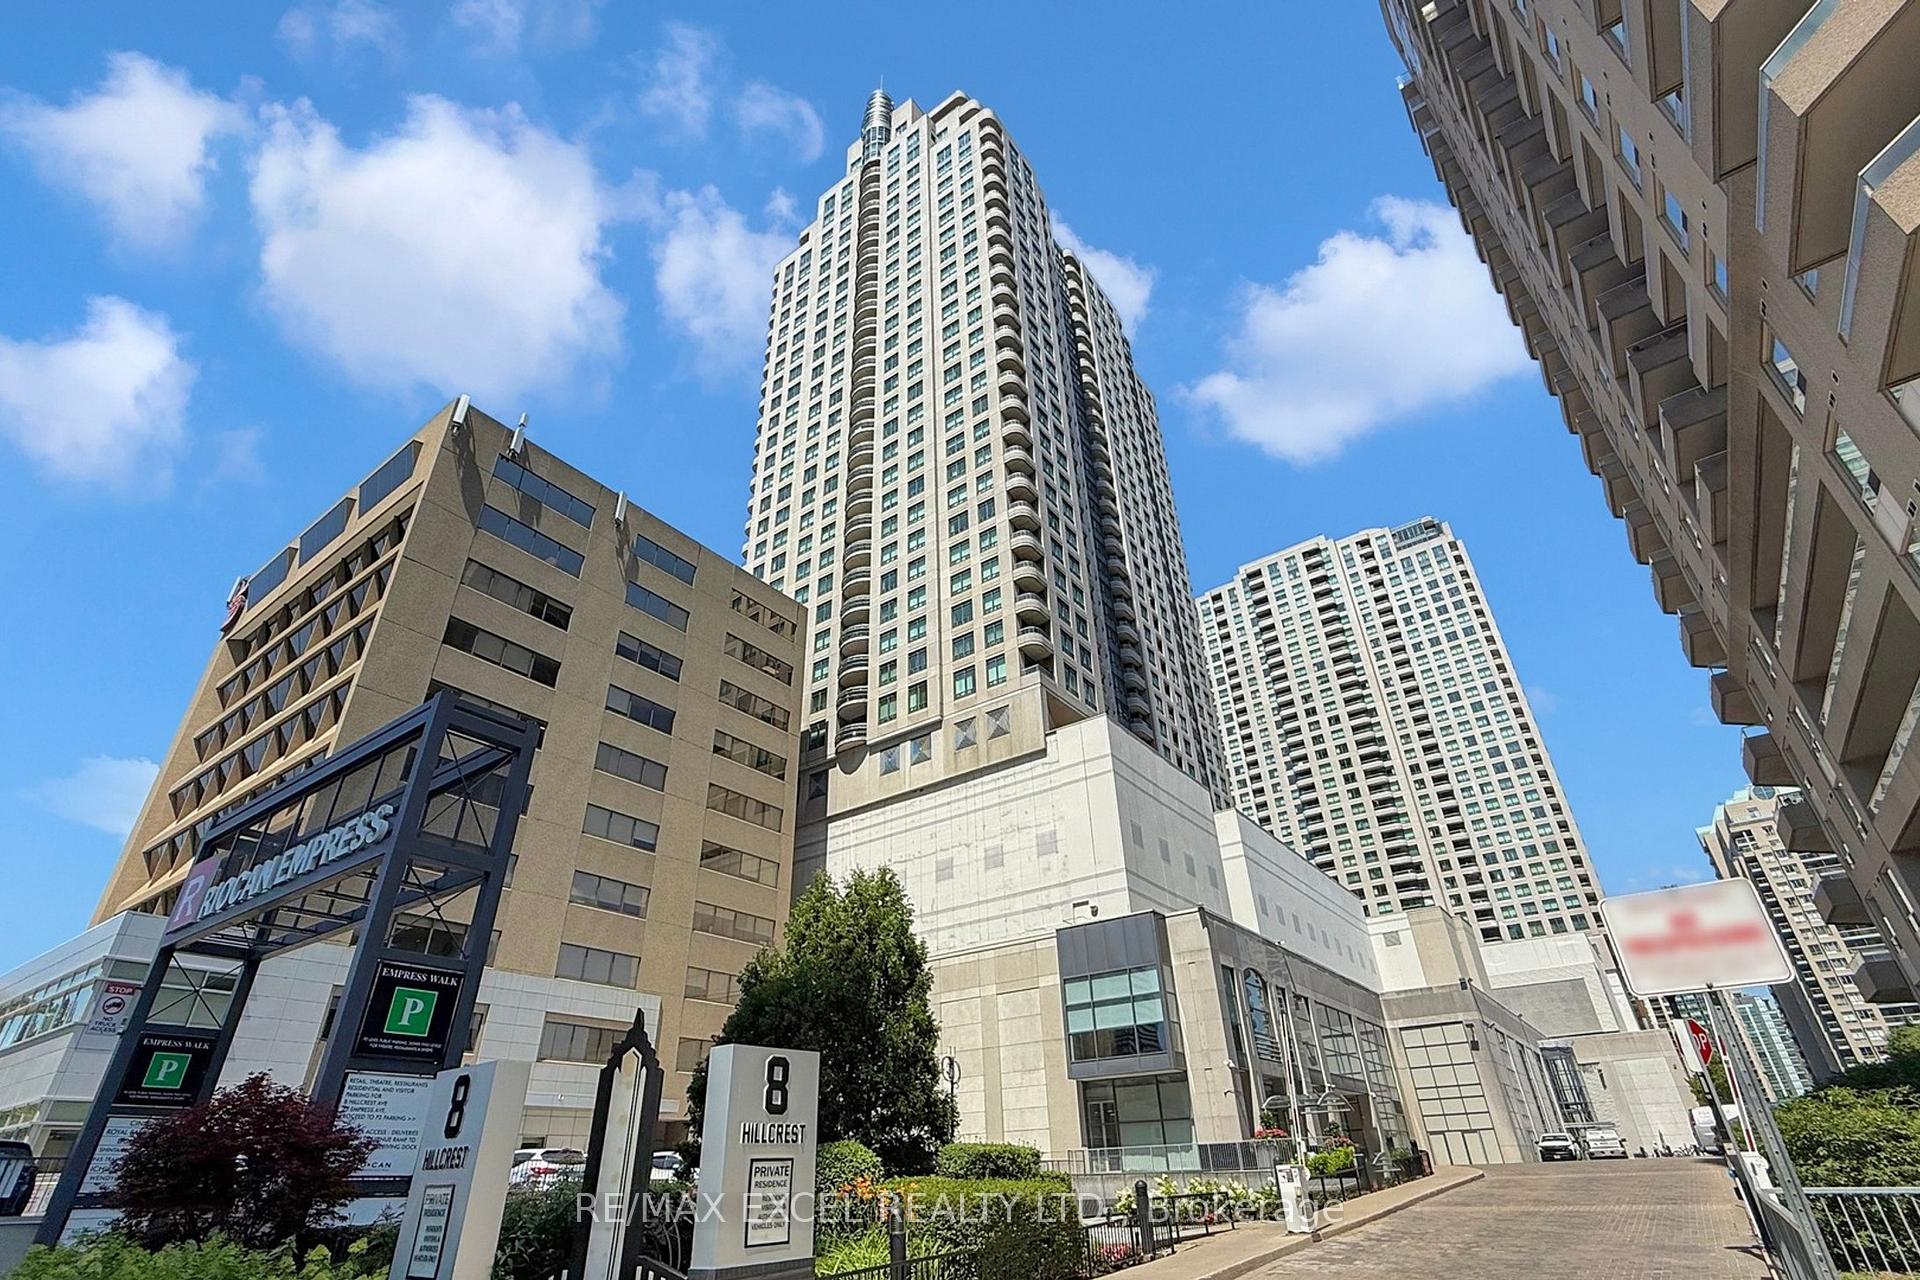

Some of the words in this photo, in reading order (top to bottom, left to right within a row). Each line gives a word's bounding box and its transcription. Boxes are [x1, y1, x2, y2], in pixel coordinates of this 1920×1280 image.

[197, 855, 282, 920] RIOCAN
[273, 803, 394, 886] EMPRESS
[382, 967, 428, 982] EMPRESS
[430, 974, 458, 986] WALK
[108, 985, 134, 994] STOP
[397, 997, 425, 1026] P
[143, 1038, 183, 1047] EMPRESS
[156, 1059, 179, 1081] P
[764, 1055, 790, 1115] 8
[443, 1074, 471, 1139] 8
[741, 1122, 805, 1144] HILLCREST
[422, 1146, 470, 1171] HILLCREST
[754, 1165, 790, 1177] PRIVATE
[754, 1179, 788, 1189] RESIDENCE
